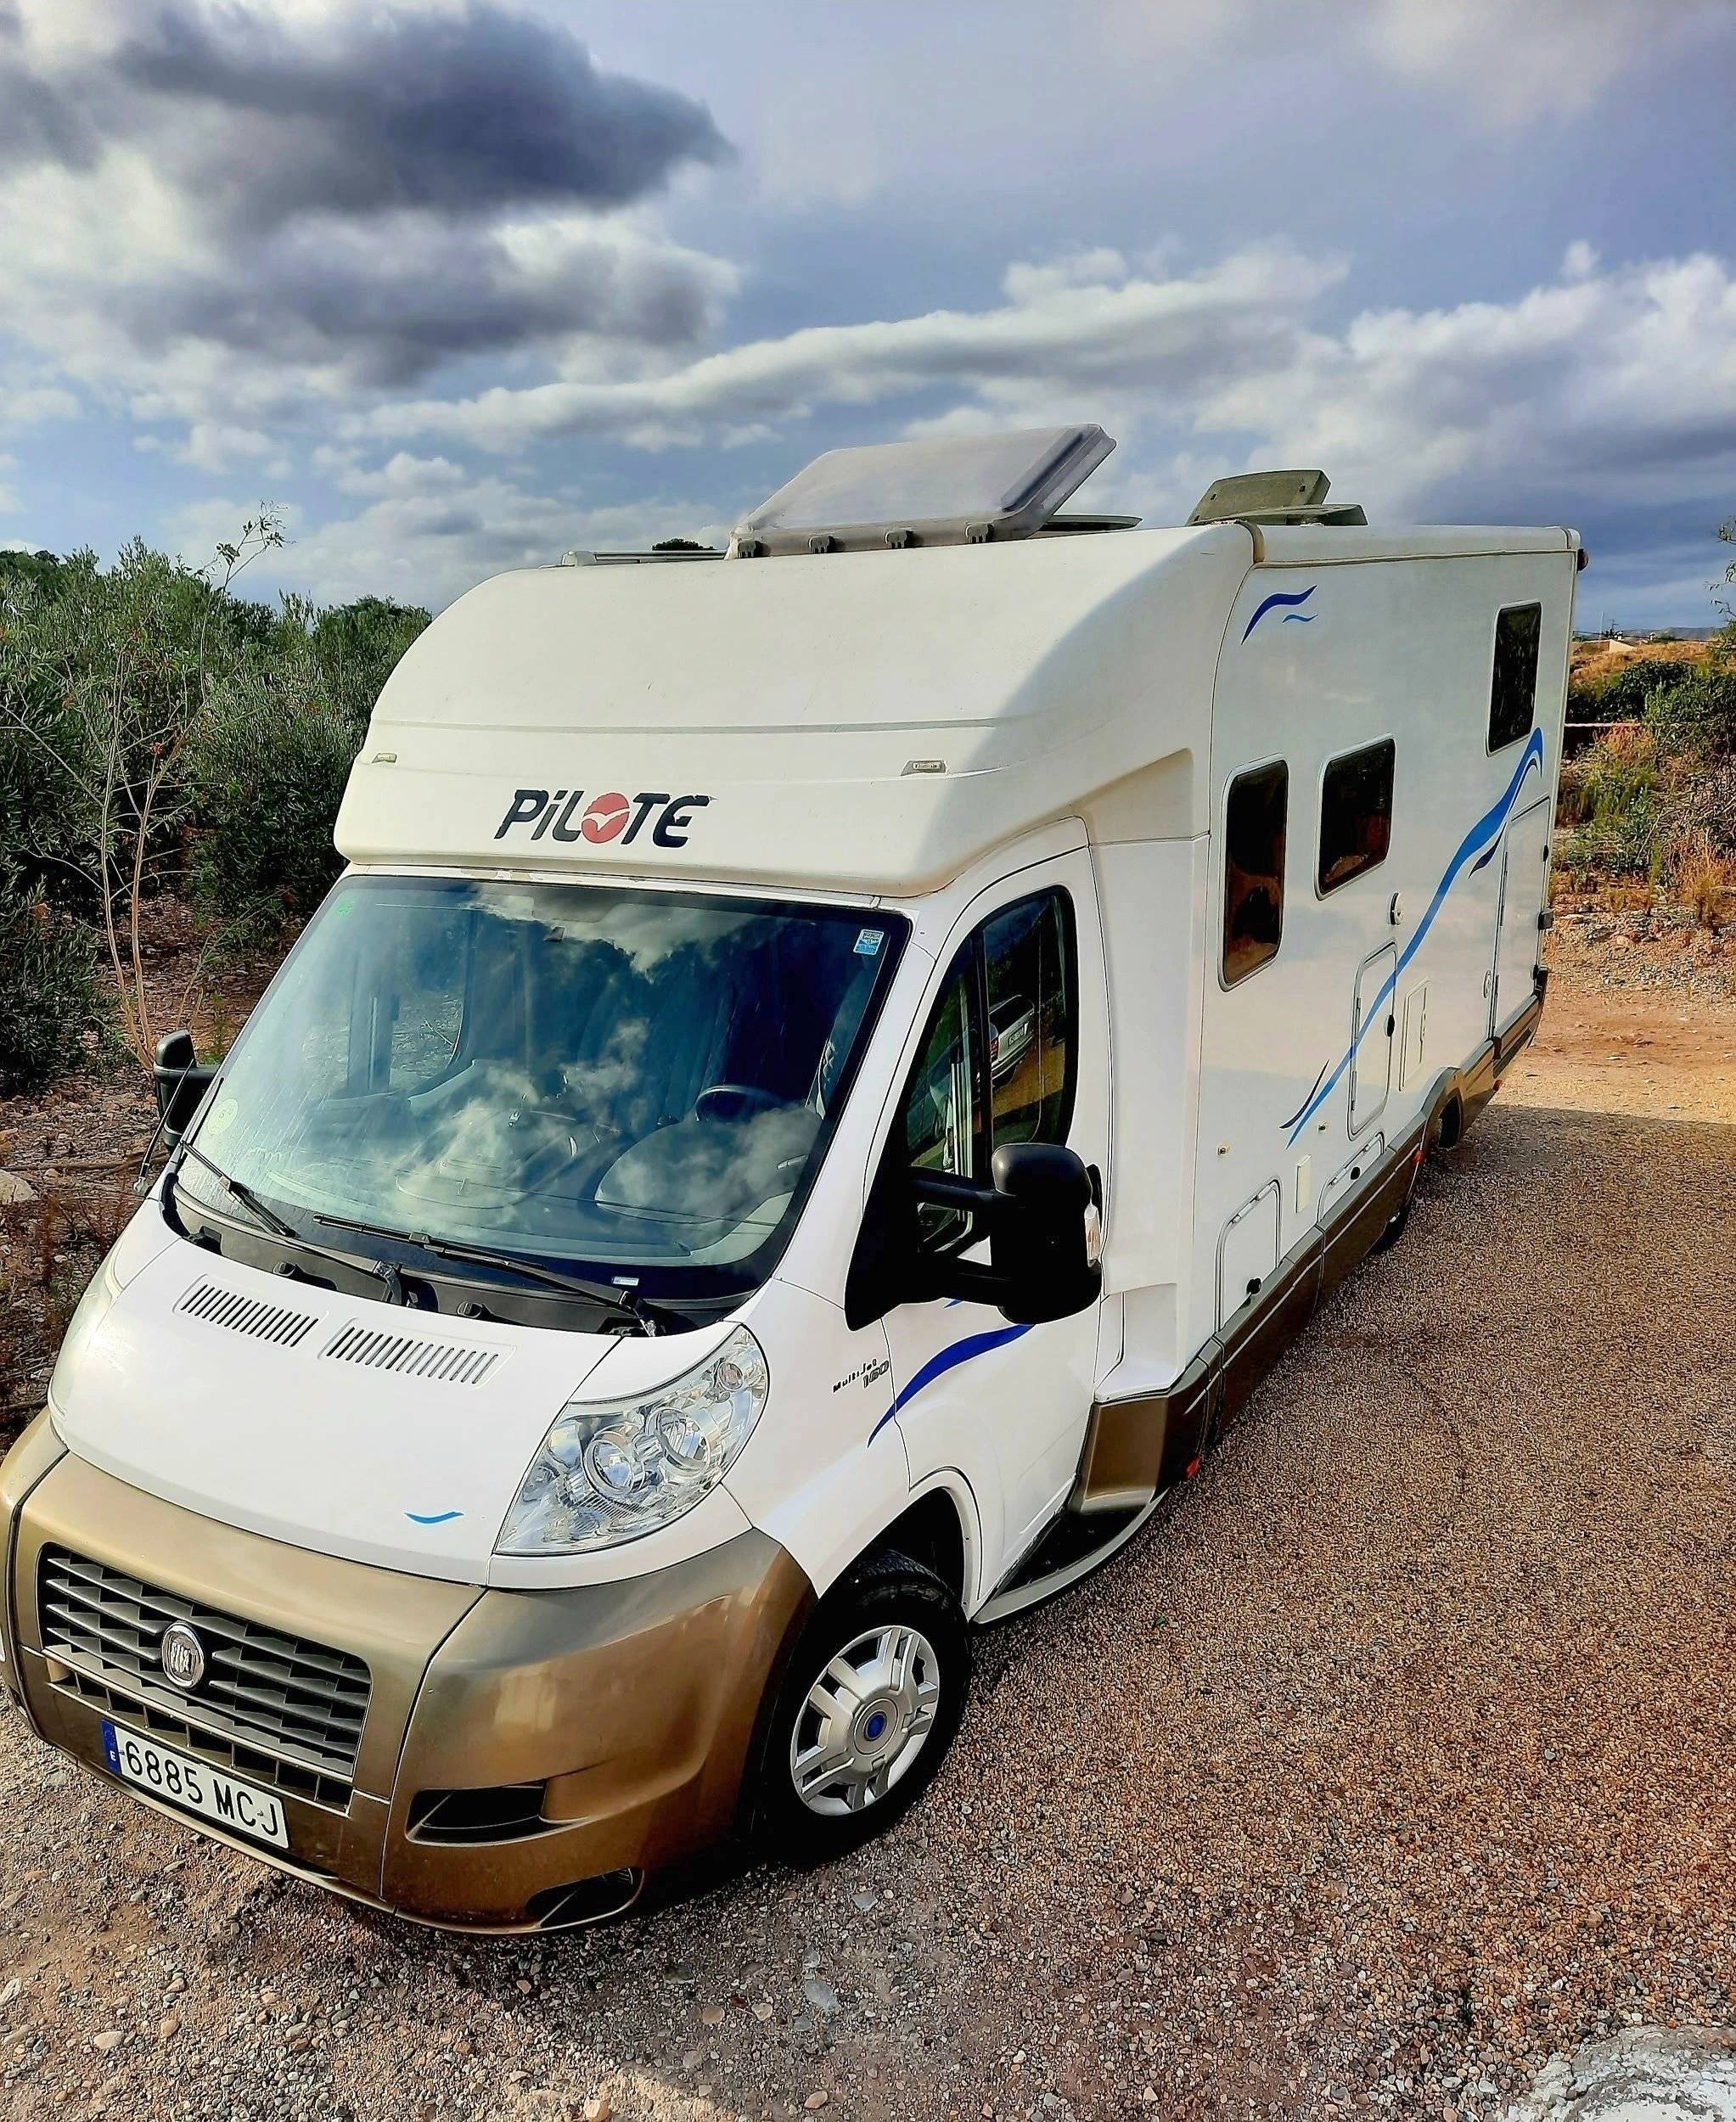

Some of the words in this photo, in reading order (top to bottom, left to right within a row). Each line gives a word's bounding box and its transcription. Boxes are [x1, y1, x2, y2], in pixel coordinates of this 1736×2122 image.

[863, 1360, 889, 1388] 160
[110, 1750, 116, 1762] E
[126, 1741, 203, 1805] 6885
[213, 1778, 278, 1836] MCJ
